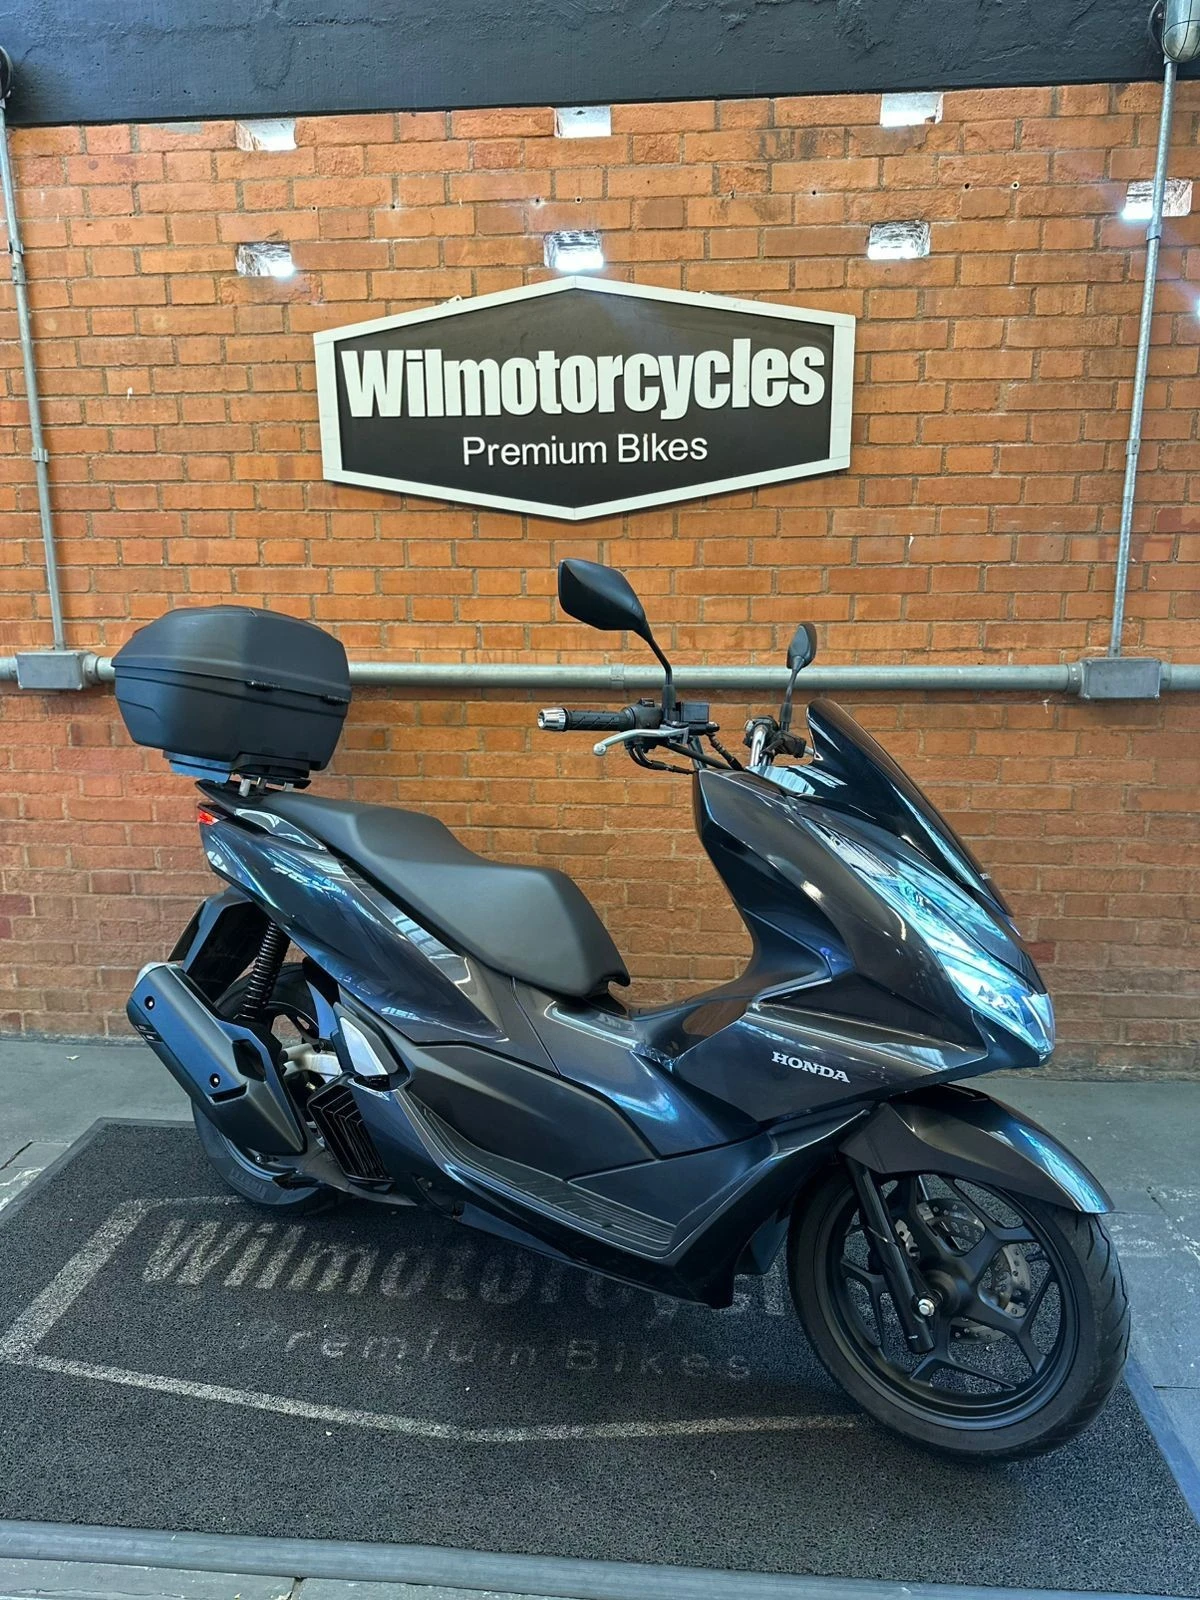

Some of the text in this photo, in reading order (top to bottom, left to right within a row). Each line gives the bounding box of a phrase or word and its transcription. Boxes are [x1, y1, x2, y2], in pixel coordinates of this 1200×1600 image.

[341, 338, 826, 421] Wilmotorcycles
[462, 435, 607, 466] Premium
[771, 1051, 850, 1083] HONDA
